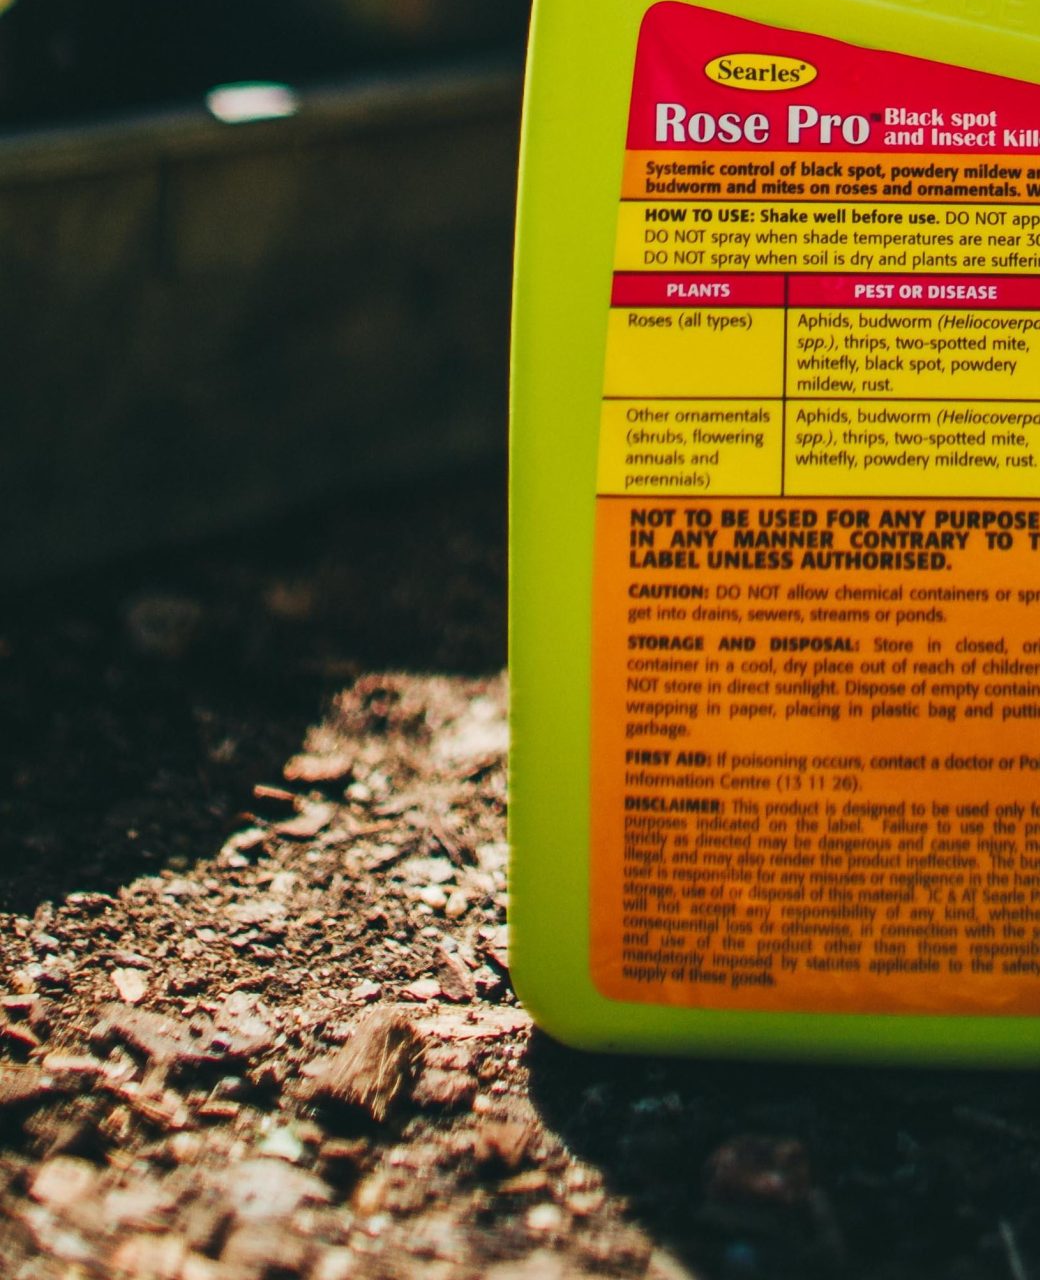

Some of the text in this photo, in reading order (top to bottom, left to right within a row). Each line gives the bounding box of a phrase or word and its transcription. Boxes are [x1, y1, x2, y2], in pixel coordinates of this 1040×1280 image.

[656, 103, 869, 144] Rose Pro
[885, 108, 996, 130] Black spot
[884, 127, 923, 146] and
[932, 127, 995, 146] Insect
[647, 161, 714, 181] Systemic
[720, 160, 774, 179] control
[780, 161, 796, 179] of
[801, 161, 842, 177] black
[848, 164, 885, 181] spot,
[891, 163, 958, 184] powdery
[964, 164, 1022, 182] mildew
[646, 178, 721, 194] budworm
[727, 179, 756, 194] and
[762, 179, 804, 195] mites
[810, 184, 830, 195] on
[836, 183, 877, 195] roses
[883, 181, 912, 196] and
[918, 182, 1020, 197] ornamentals.
[646, 208, 687, 222] HOW
[693, 208, 712, 222] TO
[718, 209, 754, 223] USE:
[761, 208, 807, 223] Shake
[814, 208, 845, 223] well
[852, 208, 902, 224] before
[909, 214, 939, 225] use.
[946, 211, 969, 225] DO
[976, 211, 1007, 226] NOT
[645, 229, 668, 244] DO
[675, 229, 705, 244] NOT
[712, 232, 750, 247] spray
[756, 229, 797, 244] when
[804, 229, 847, 244] shade
[854, 231, 953, 249] temperatures
[959, 235, 982, 246] are
[988, 235, 1021, 247] near
[644, 251, 668, 265] DO
[674, 250, 705, 265] NOT
[711, 253, 750, 269] spray
[755, 250, 797, 265] when
[803, 250, 827, 265] soil
[834, 251, 845, 265] is
[851, 250, 873, 269] dry
[879, 251, 906, 266] and
[913, 251, 957, 271] plants
[963, 256, 985, 267] are
[667, 283, 730, 297] PLANTS
[855, 284, 996, 299] PEST OR DISEASE
[629, 312, 752, 331] Roses (all types)
[798, 313, 852, 332] Aphids,
[859, 313, 931, 328] budworm
[798, 334, 1029, 354] spp.), thrips, two-spotted mite,
[798, 355, 1016, 375] whitefly, black spot, powdery
[798, 376, 893, 393] mildew, rust.
[627, 407, 770, 423] Other ornamentals
[625, 471, 710, 490] perennials)
[631, 508, 676, 528] NOT
[685, 508, 712, 528] TO
[721, 510, 748, 528] BE
[759, 509, 817, 529] USED
[827, 509, 870, 529] FOR
[879, 509, 925, 529] ANY
[935, 510, 1039, 530] PURPOSE
[631, 529, 654, 548] IN
[671, 528, 717, 548] ANY
[734, 529, 833, 549] MANNER
[850, 530, 969, 550] CONTRARY
[985, 530, 1013, 550] TO
[630, 550, 951, 570] LABEL UNLESS AUTHORISED.
